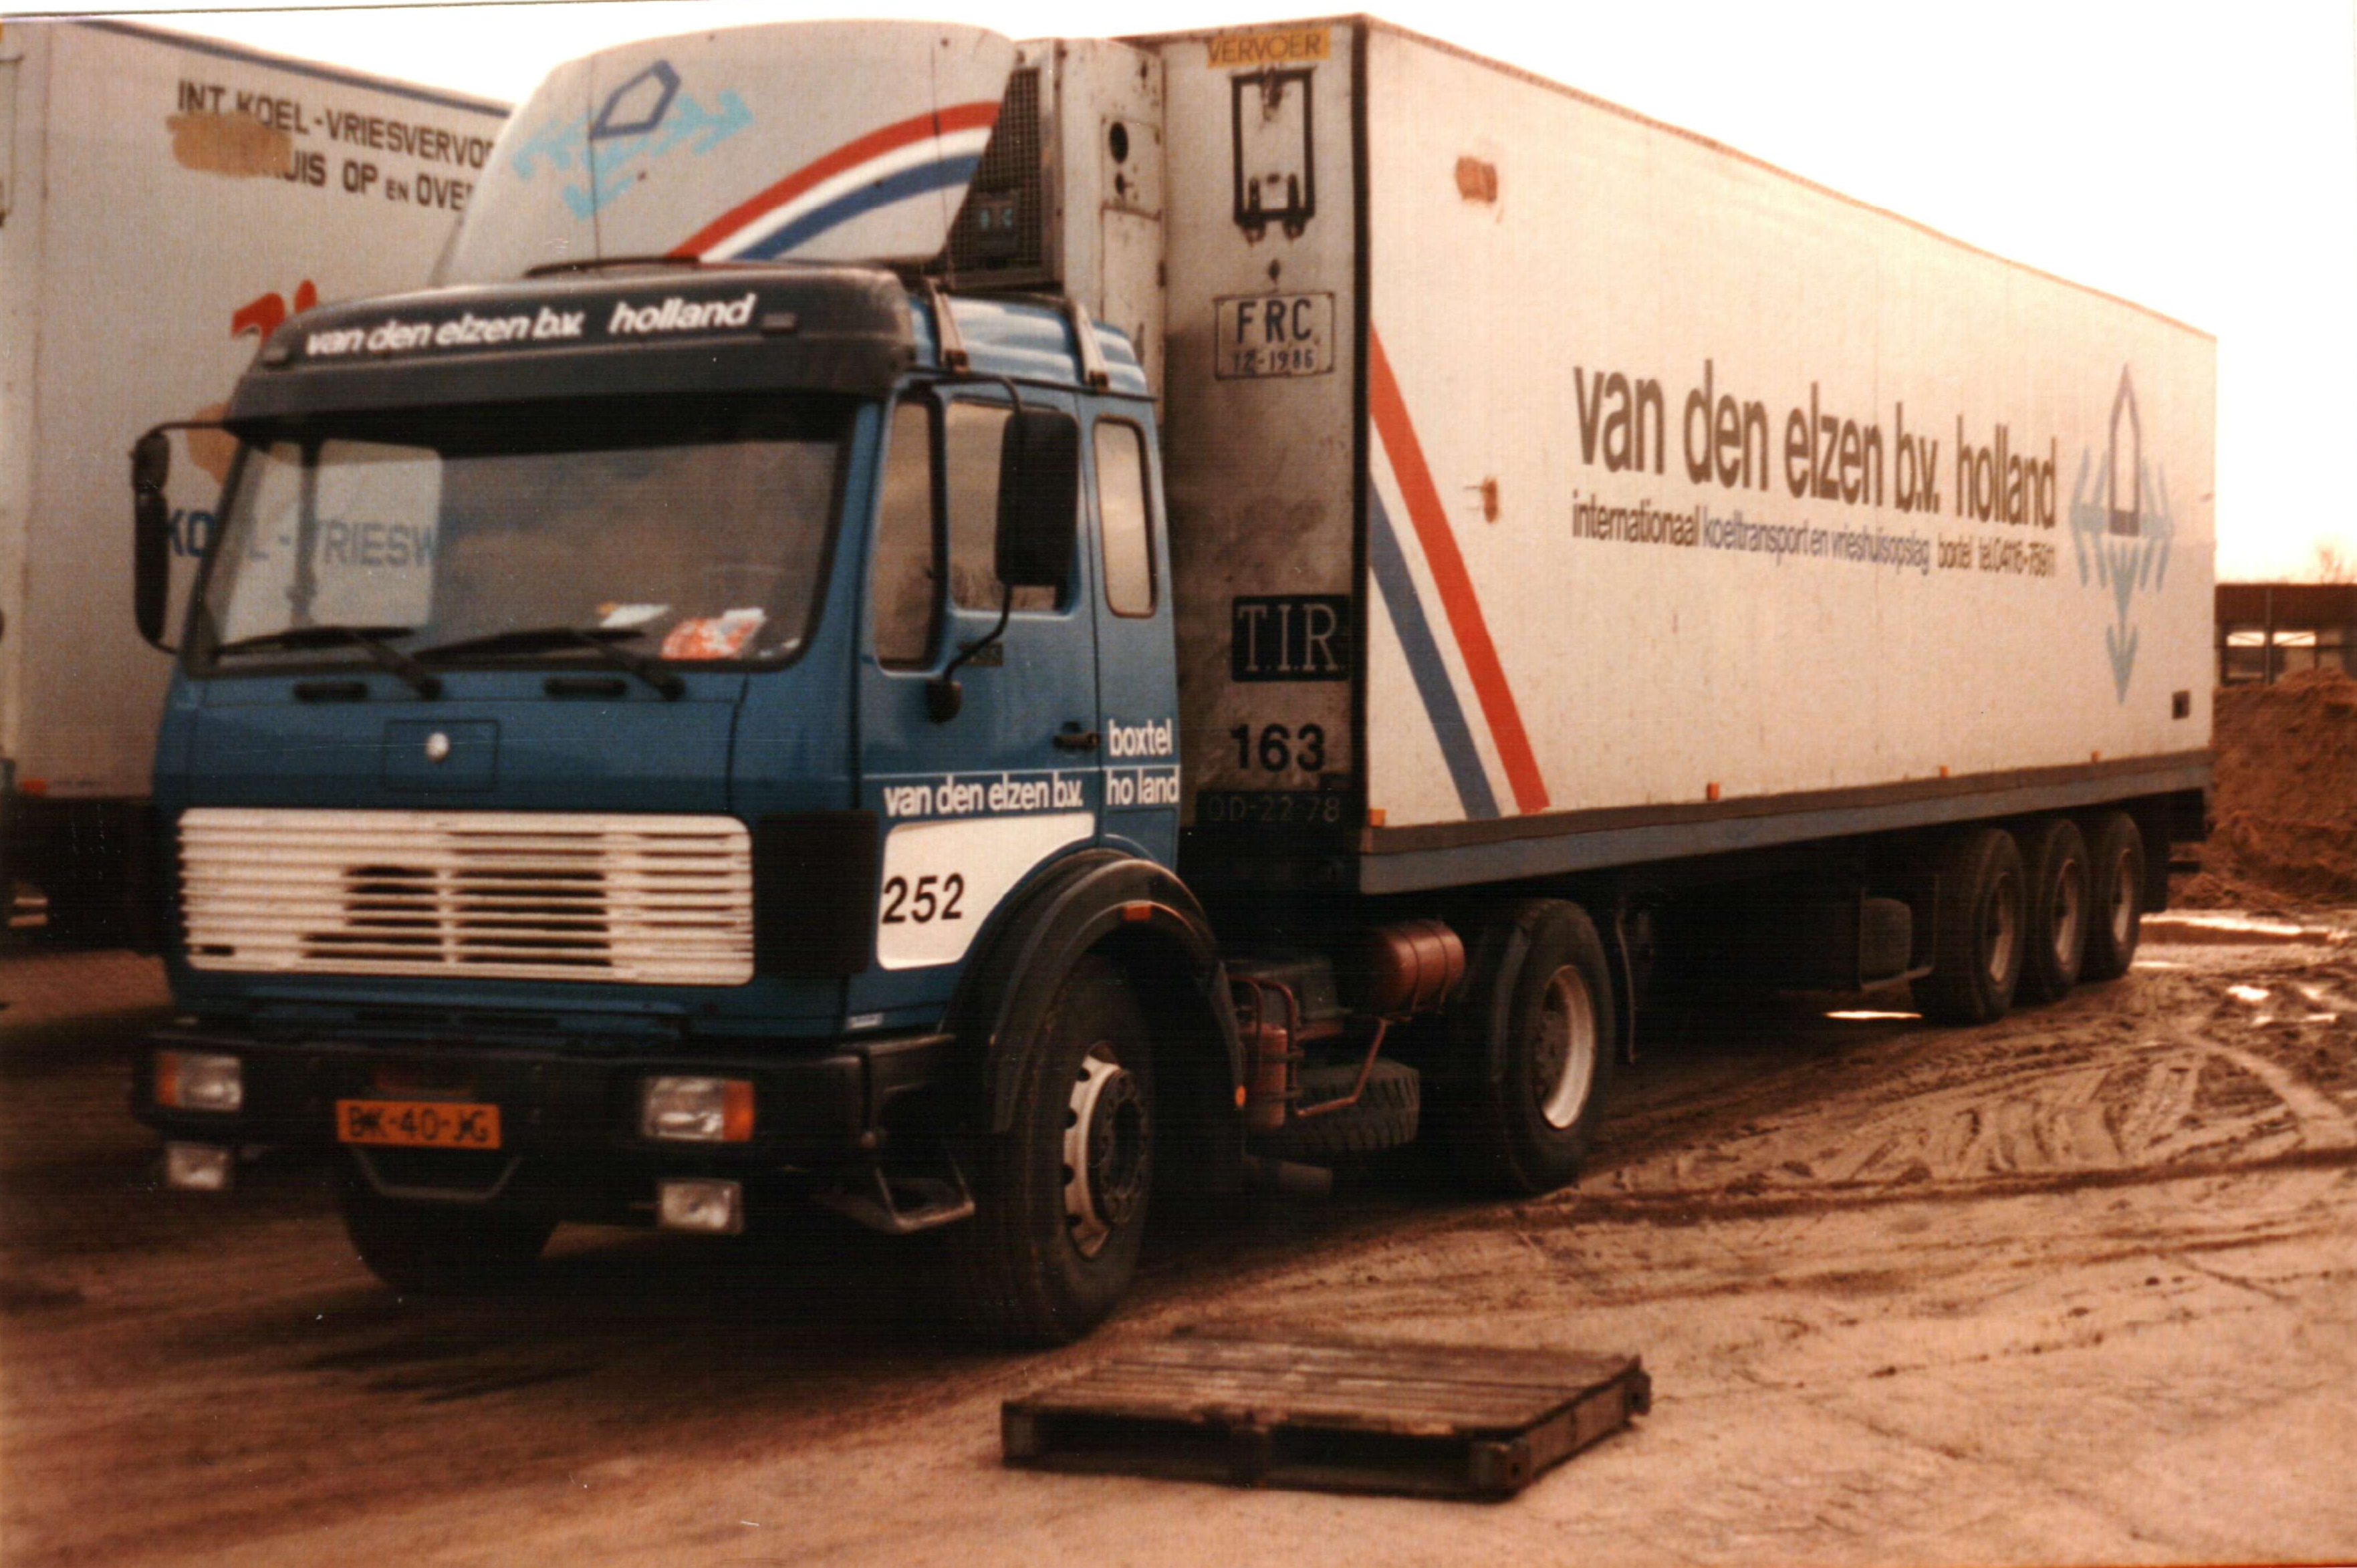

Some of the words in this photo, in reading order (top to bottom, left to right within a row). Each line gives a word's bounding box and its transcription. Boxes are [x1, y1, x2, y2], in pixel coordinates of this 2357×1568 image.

[1205, 33, 1321, 62] VERVOER
[342, 158, 378, 194] OP
[386, 178, 408, 202] EN
[306, 329, 365, 356] van
[368, 319, 432, 352] den
[435, 312, 531, 346] elzen
[608, 293, 757, 334] holland
[1237, 299, 1312, 344] FRC
[1573, 366, 1665, 475] van
[1684, 359, 1769, 491] den
[1784, 381, 1884, 506] elzen
[1895, 401, 1941, 515] b.v.
[1956, 414, 2056, 530] holland
[1573, 489, 1701, 547] internationaal
[1108, 718, 1172, 757] boxtel
[1230, 723, 1324, 772] 163
[884, 785, 932, 817] van
[936, 773, 985, 814] den
[988, 771, 1049, 810] elzen
[882, 872, 964, 924] 252
